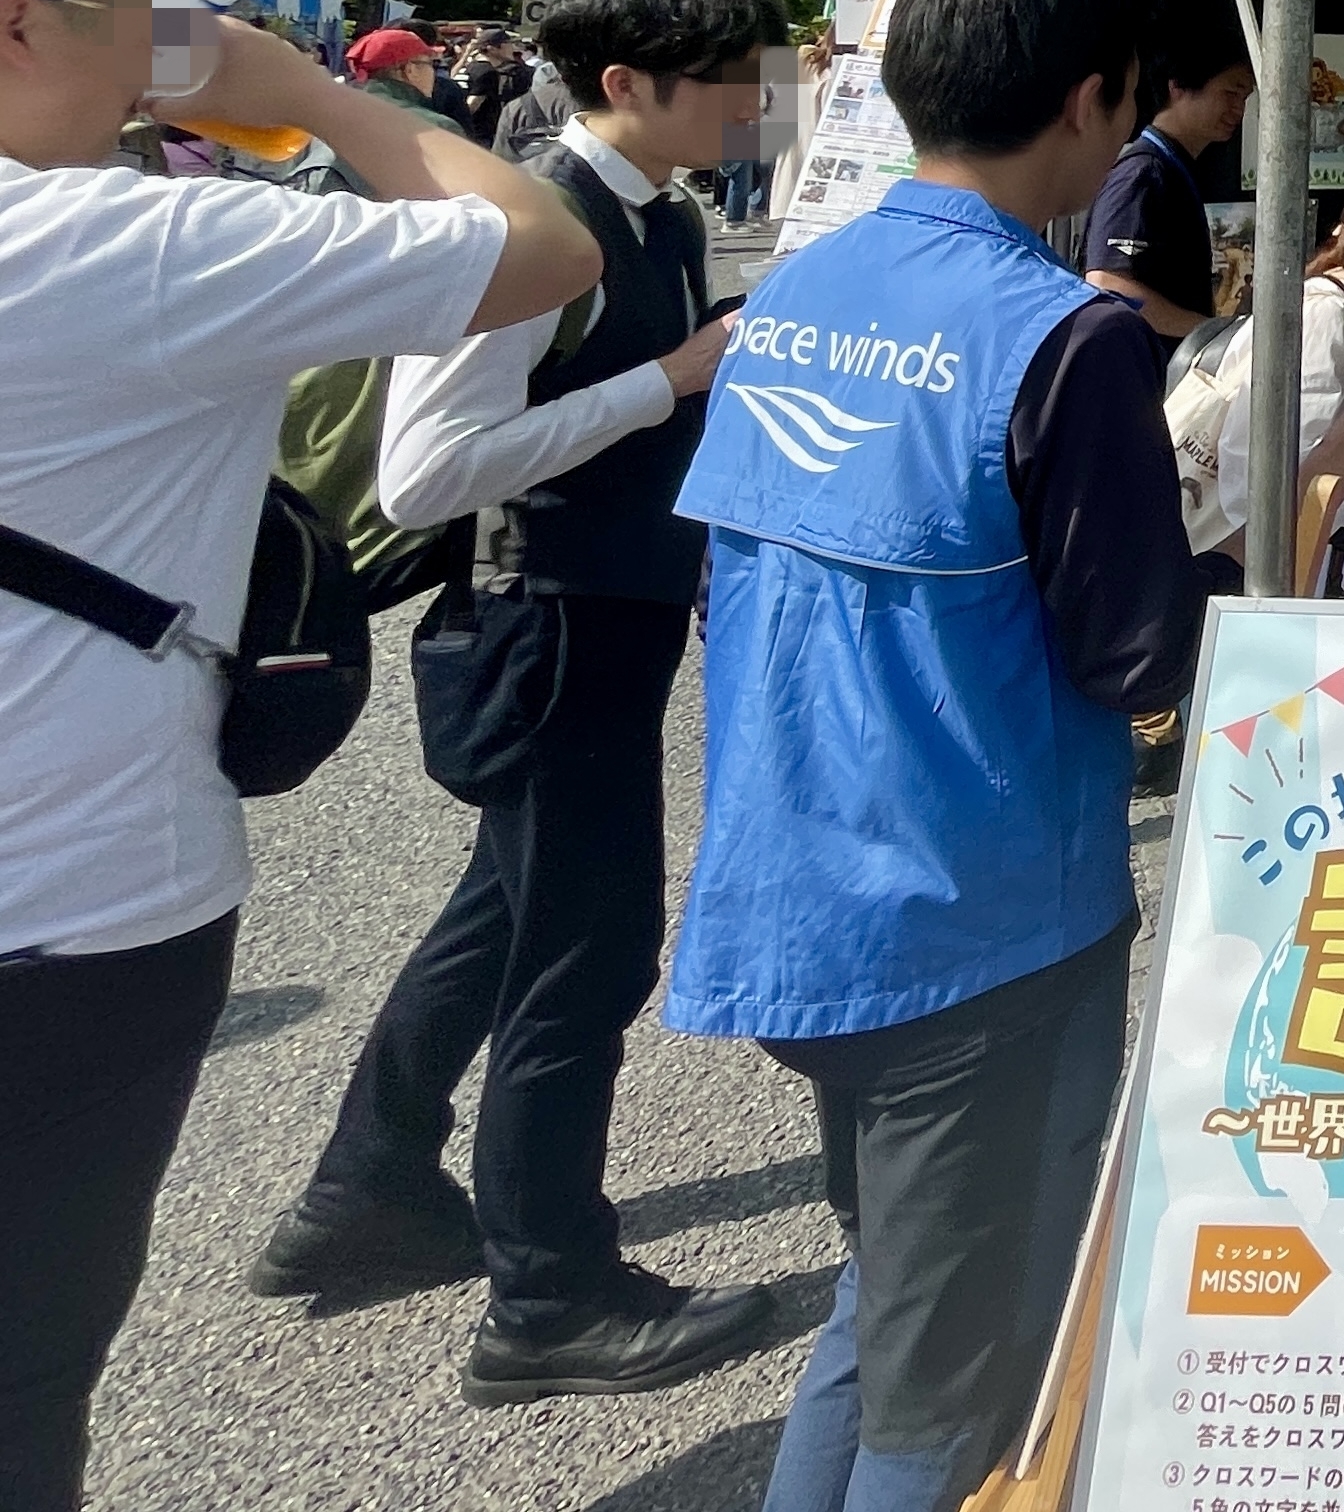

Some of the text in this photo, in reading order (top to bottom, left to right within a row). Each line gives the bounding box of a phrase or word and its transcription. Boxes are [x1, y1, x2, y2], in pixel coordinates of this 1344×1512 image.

[828, 322, 960, 393] winds
[1215, 1243, 1290, 1261] ミッション
[1200, 1269, 1301, 1295] MISSION
